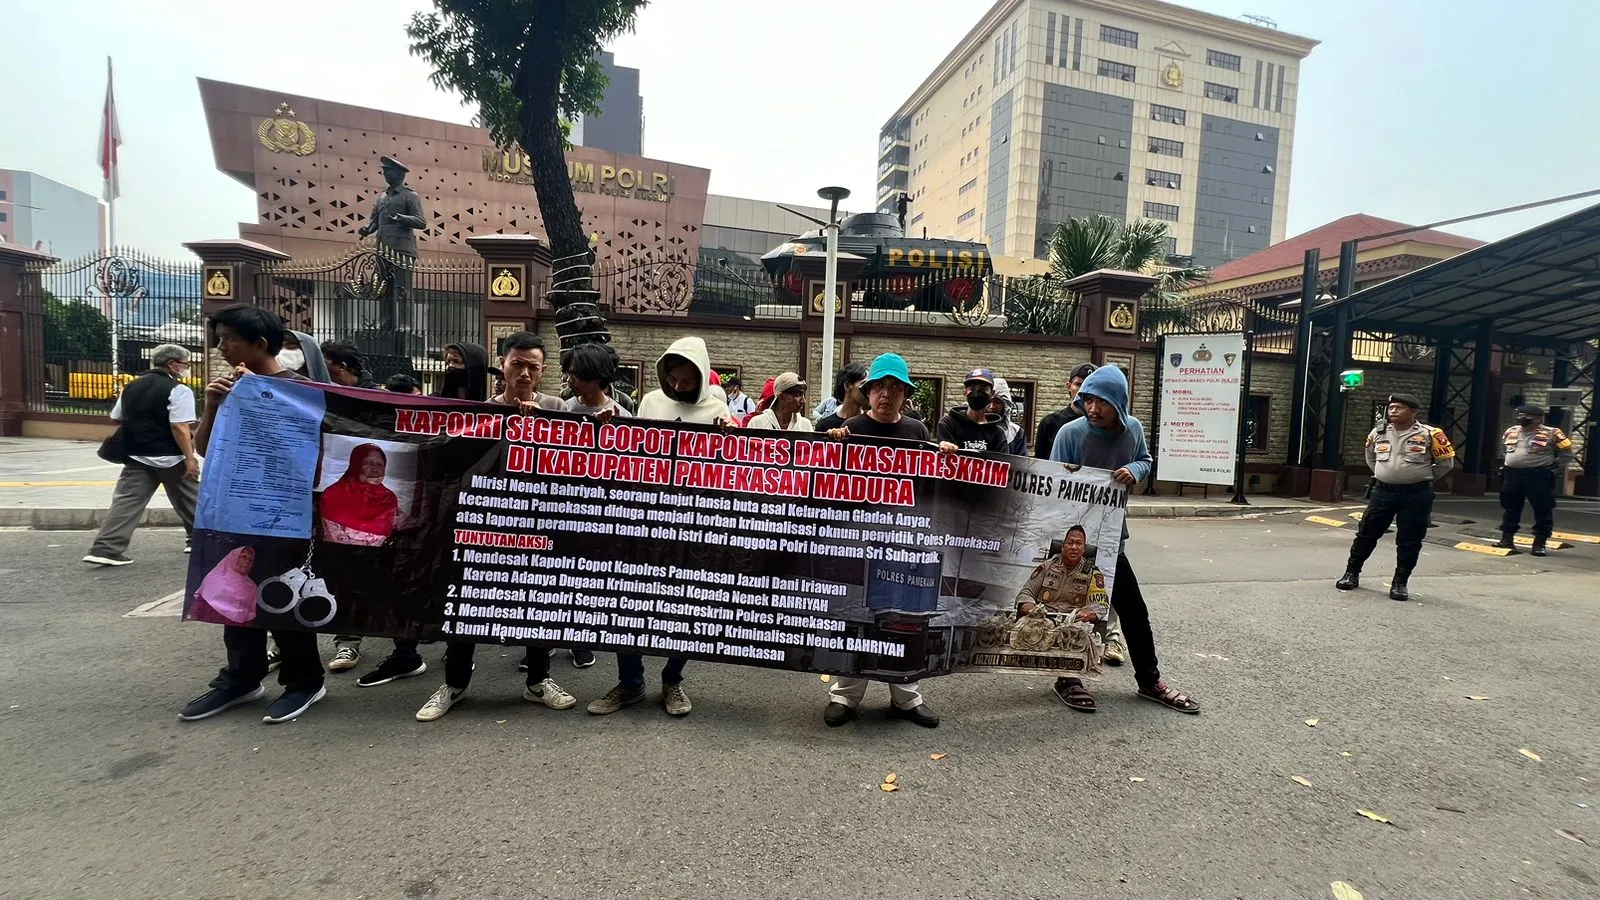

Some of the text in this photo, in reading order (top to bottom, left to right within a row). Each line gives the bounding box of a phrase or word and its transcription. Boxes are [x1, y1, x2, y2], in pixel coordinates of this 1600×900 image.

[482, 149, 676, 195] MUSM POLRI
[488, 173, 534, 185] INDONESI
[600, 186, 631, 198] POLICE
[888, 247, 985, 270] POLISI
[1179, 367, 1225, 375] PERHATIAN
[395, 408, 1010, 488] KAPOLRI SEGERA COPOT KAPOLRES DAN KASATRESKRIM
[506, 445, 915, 507] DI KABUPATEN PAMEKASAN MADURA
[458, 492, 1001, 552] Kecamatan Pamekasan diduga menjadi korban kriminalisasi oknum penyidik Polres Pamekasan
[471, 475, 931, 529] Miris! Nenek Bahriyah, seorang lanjut lansia buta asal Kelurahan Gladak Anyar,
[454, 529, 517, 547] TUNTUTAN
[456, 511, 484, 525] atas
[486, 512, 534, 529] laporan
[537, 518, 613, 535] perampasan
[616, 524, 649, 538] tanah
[651, 527, 676, 541] oleh
[678, 529, 702, 543] istri
[704, 531, 728, 546] dari
[730, 536, 777, 551] anggota
[780, 539, 808, 554] Polri
[810, 542, 864, 559] bernama
[866, 546, 883, 560] Sri
[452, 548, 847, 596] 1. Mendesak Kapolri Copot Kapolres Pamekasan Jazuli Dani Iriawan
[463, 567, 829, 612] Karena Adanya Dugaan Kriminalisasi Kepada Nenek BAHRIYAH
[877, 569, 905, 584] POLRES
[444, 602, 905, 657] 3. Mendesak Kapolri Wajib Turun Tangan, STOP Kriminalisasi Nenek BAHRIYAH
[447, 584, 846, 632] 2. Mendesak Kapolri Segera Copot Kasatreskrim Polres Pamekasan
[442, 621, 785, 662] 4. Bumi Hanguskan Mafia Tanah di Kabupaten Pamekasan
